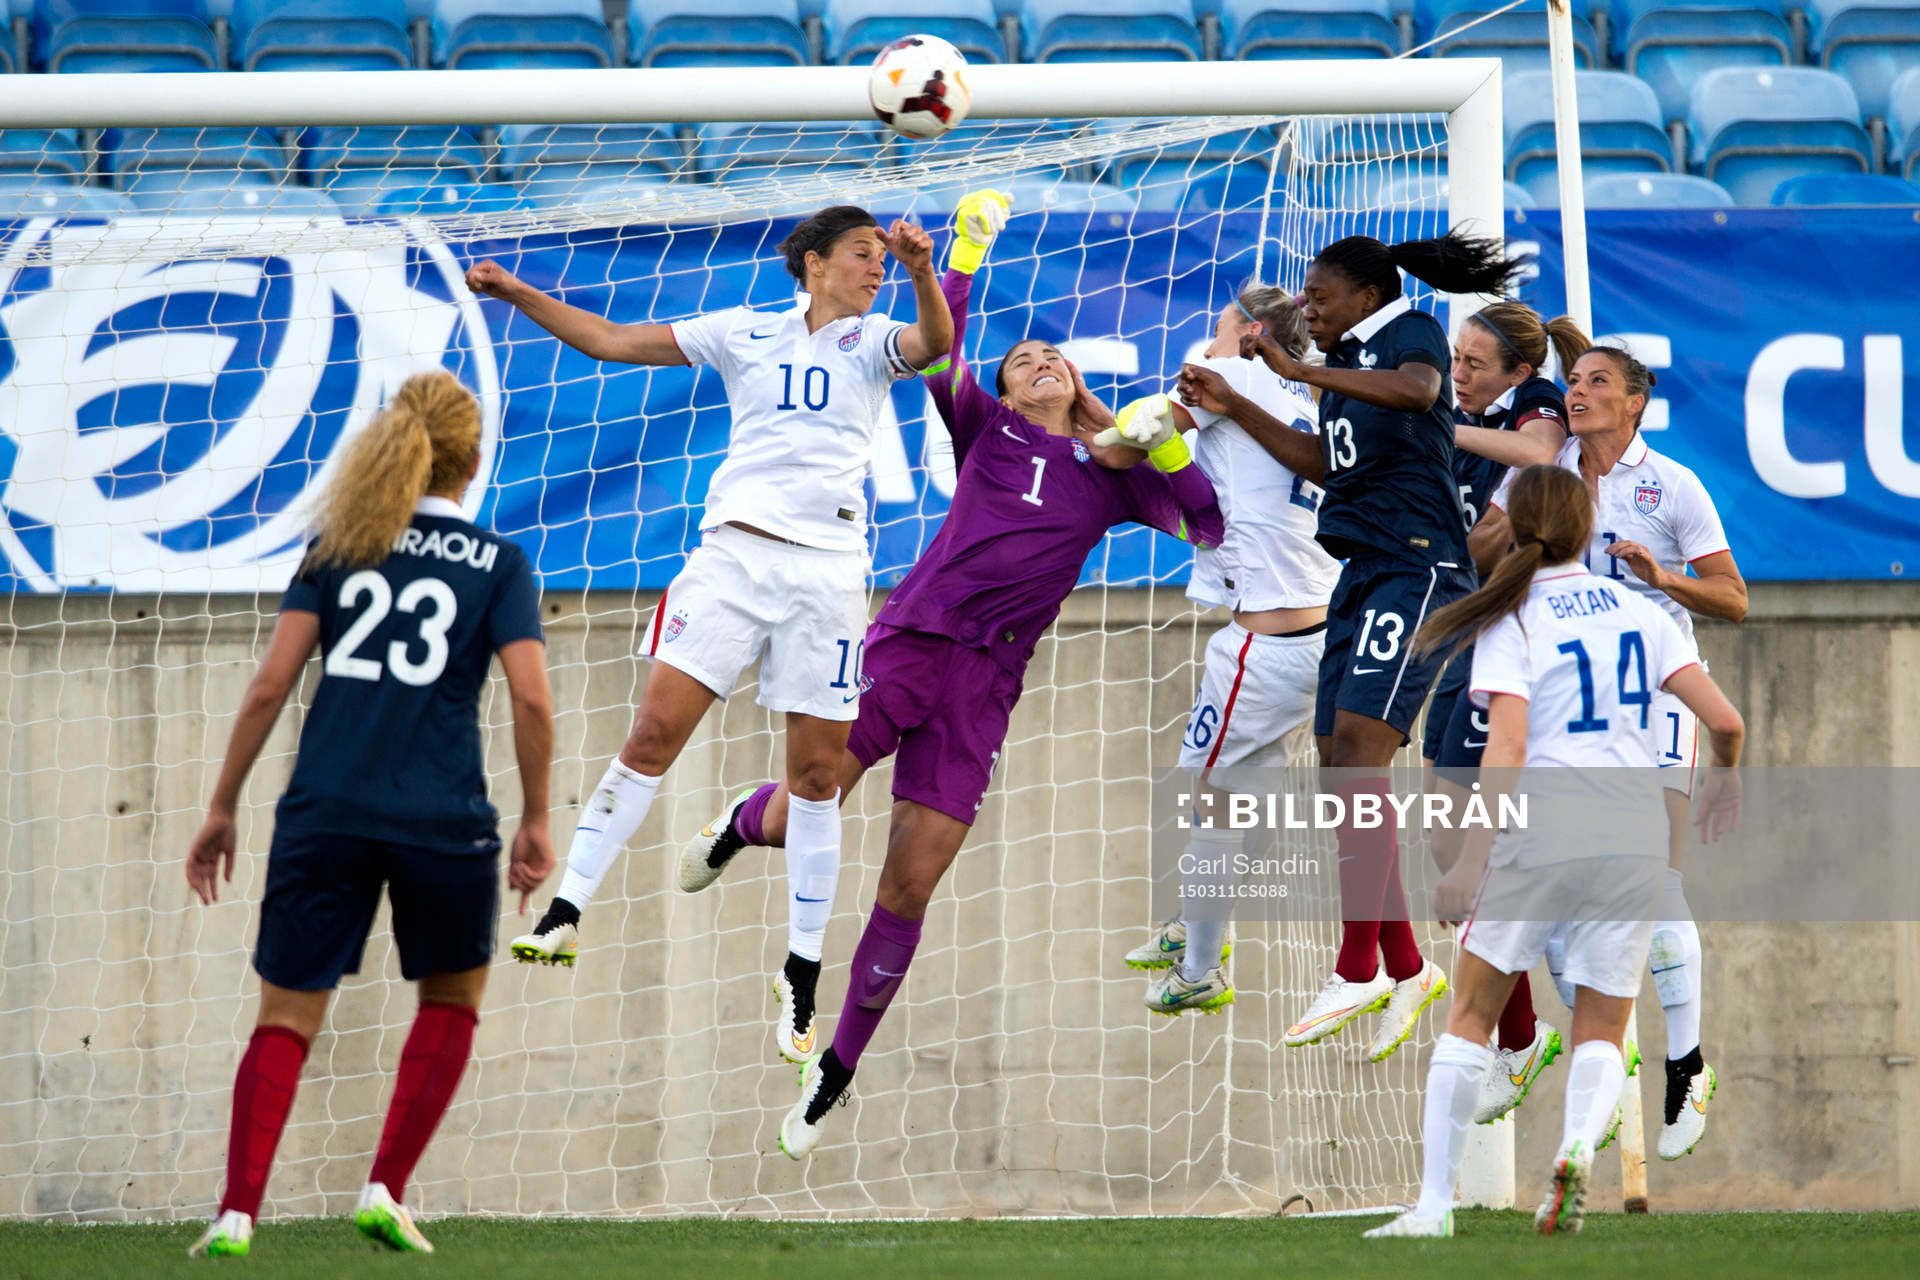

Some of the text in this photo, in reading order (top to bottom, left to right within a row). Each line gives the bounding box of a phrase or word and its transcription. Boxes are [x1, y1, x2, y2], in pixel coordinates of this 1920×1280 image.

[777, 363, 830, 411] 10
[1325, 417, 1357, 471] 13
[1021, 455, 1046, 506] 1
[325, 569, 458, 686] 23
[1547, 586, 1620, 619] BRIAN
[1355, 609, 1405, 661] 13
[1556, 630, 1652, 734] 14
